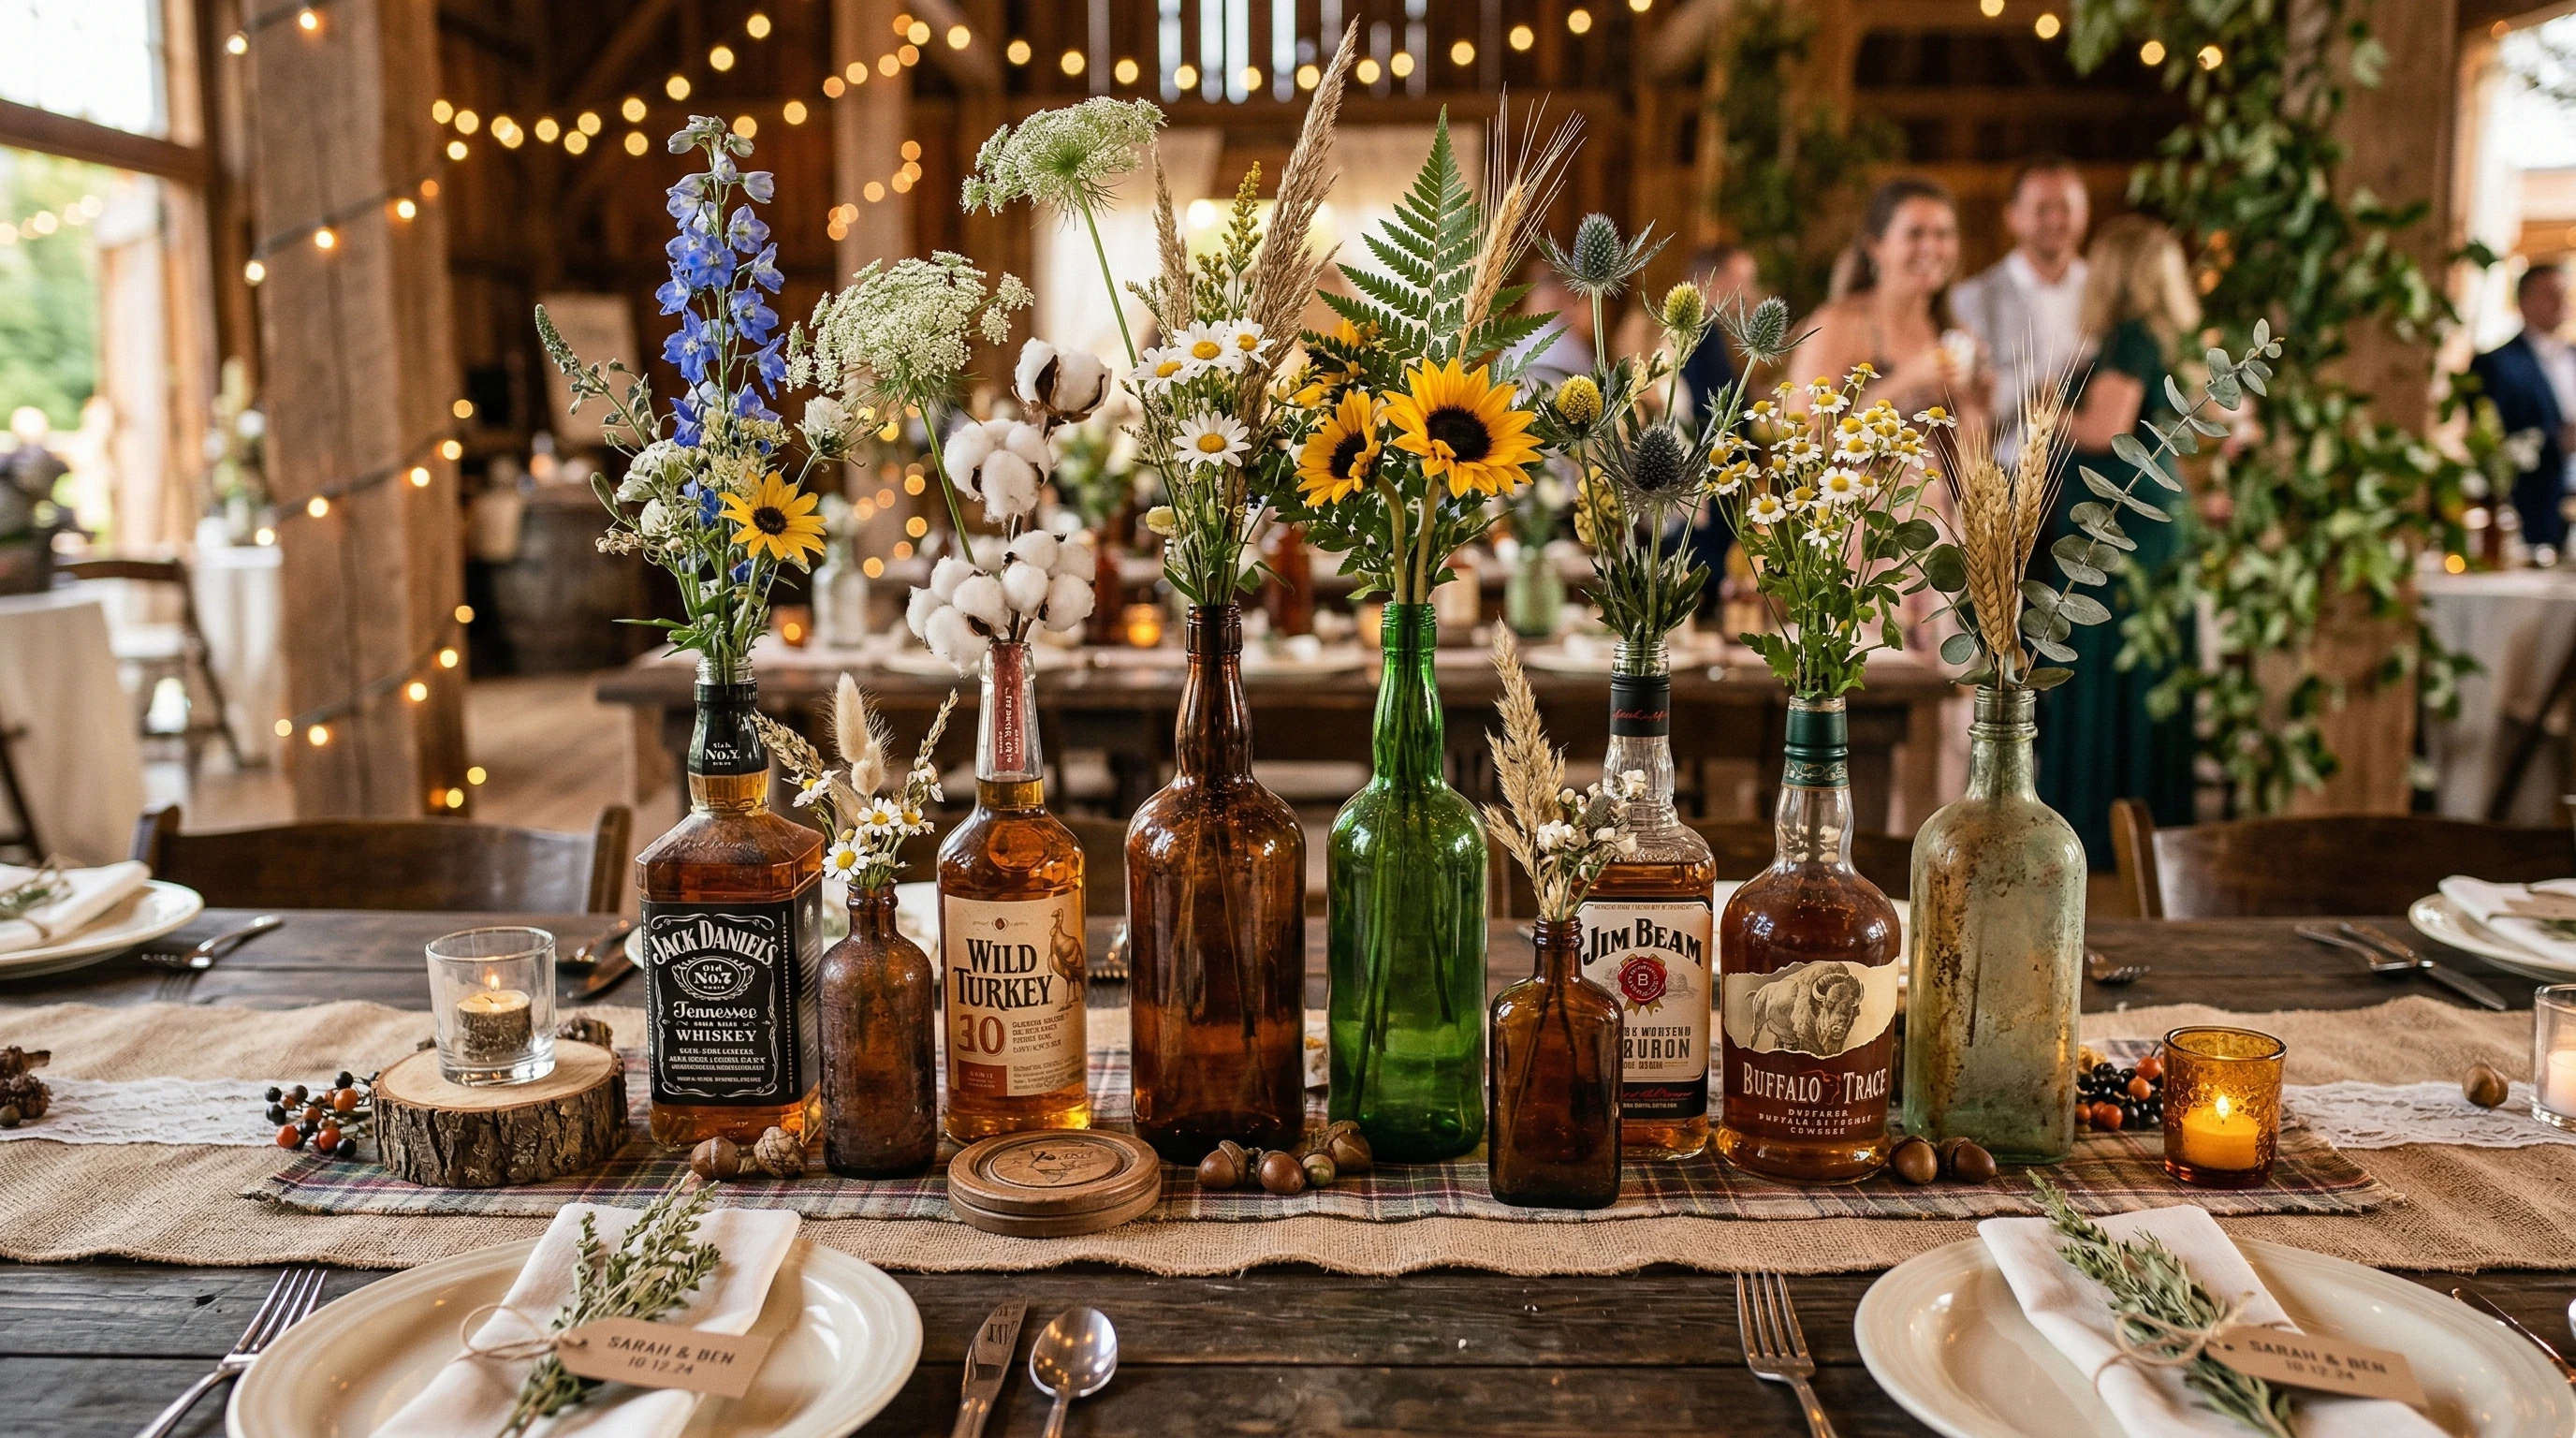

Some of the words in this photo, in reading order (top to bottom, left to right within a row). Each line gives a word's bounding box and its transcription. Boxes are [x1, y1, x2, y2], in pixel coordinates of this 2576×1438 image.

[650, 928, 699, 964] JACK
[698, 920, 779, 965] DANIEL'S
[966, 938, 1037, 974] WILD
[1583, 926, 1631, 966] JIM
[1634, 918, 1703, 968] BEAM
[694, 972, 732, 984] No.7
[953, 966, 1053, 1011] TURKEY
[1638, 974, 1648, 986] B
[674, 1001, 757, 1019] Tennessee
[676, 1030, 756, 1042] WHISKEY
[1743, 1062, 1822, 1104] BUFFALO
[1843, 1068, 1886, 1105] TRACE
[607, 1335, 672, 1357] SARAH
[676, 1346, 690, 1359] &
[696, 1348, 736, 1365] BEN
[2249, 1340, 2317, 1361] SARAH
[2325, 1353, 2340, 1366] &
[2347, 1357, 2387, 1373] BEN
